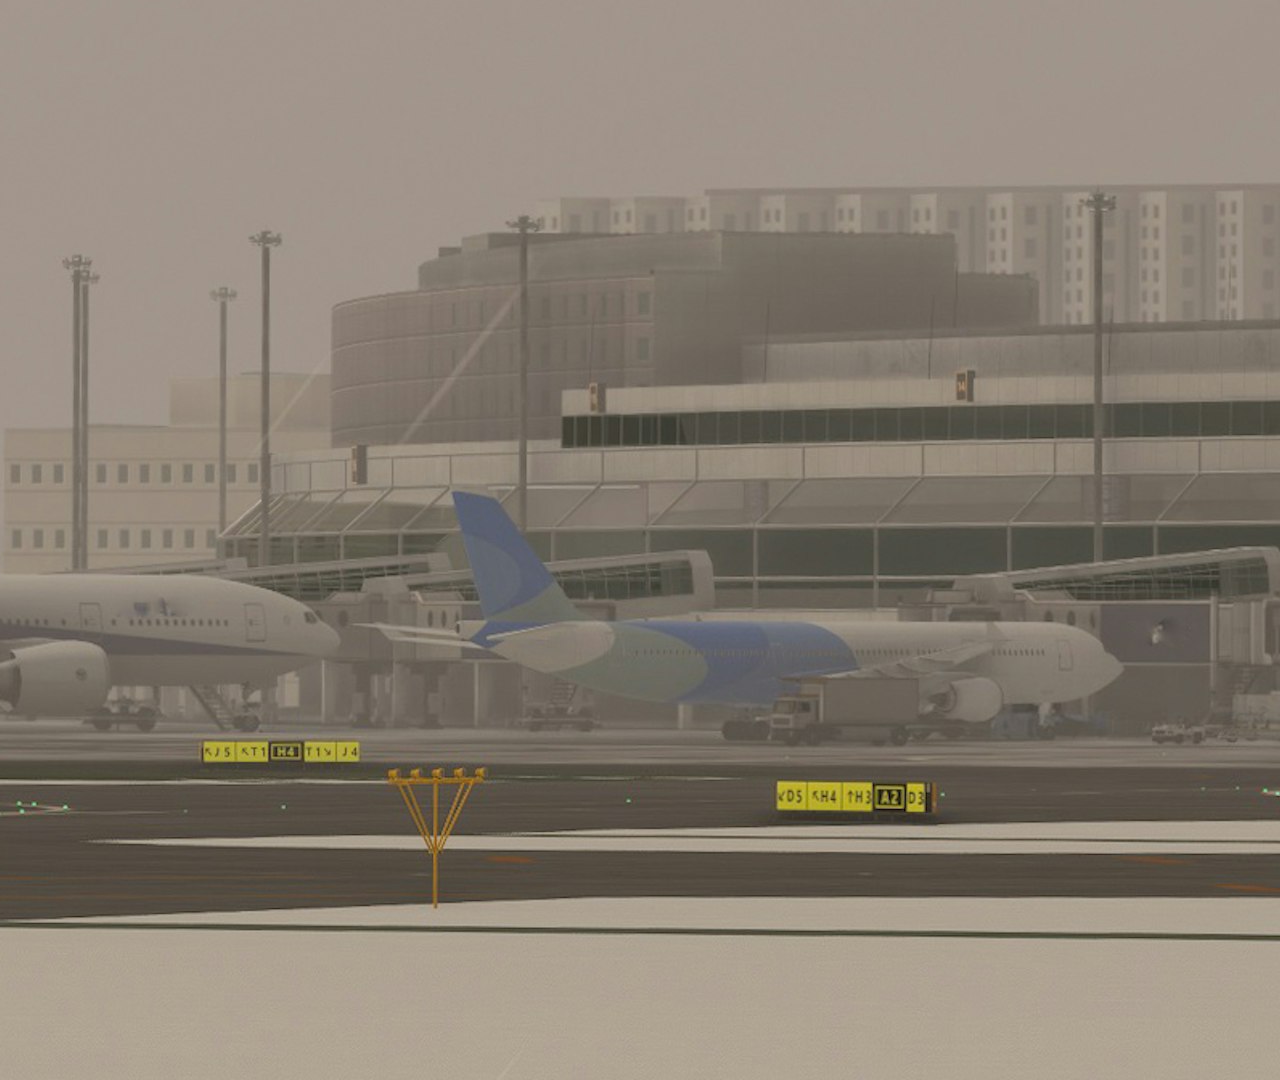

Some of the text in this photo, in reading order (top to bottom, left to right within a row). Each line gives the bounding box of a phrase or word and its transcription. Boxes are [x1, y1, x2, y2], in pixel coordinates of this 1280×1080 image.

[251, 746, 266, 757] T1
[307, 746, 321, 757] T1
[342, 747, 358, 757] J4
[787, 790, 924, 805] D5 H4 H3 A2 D3
